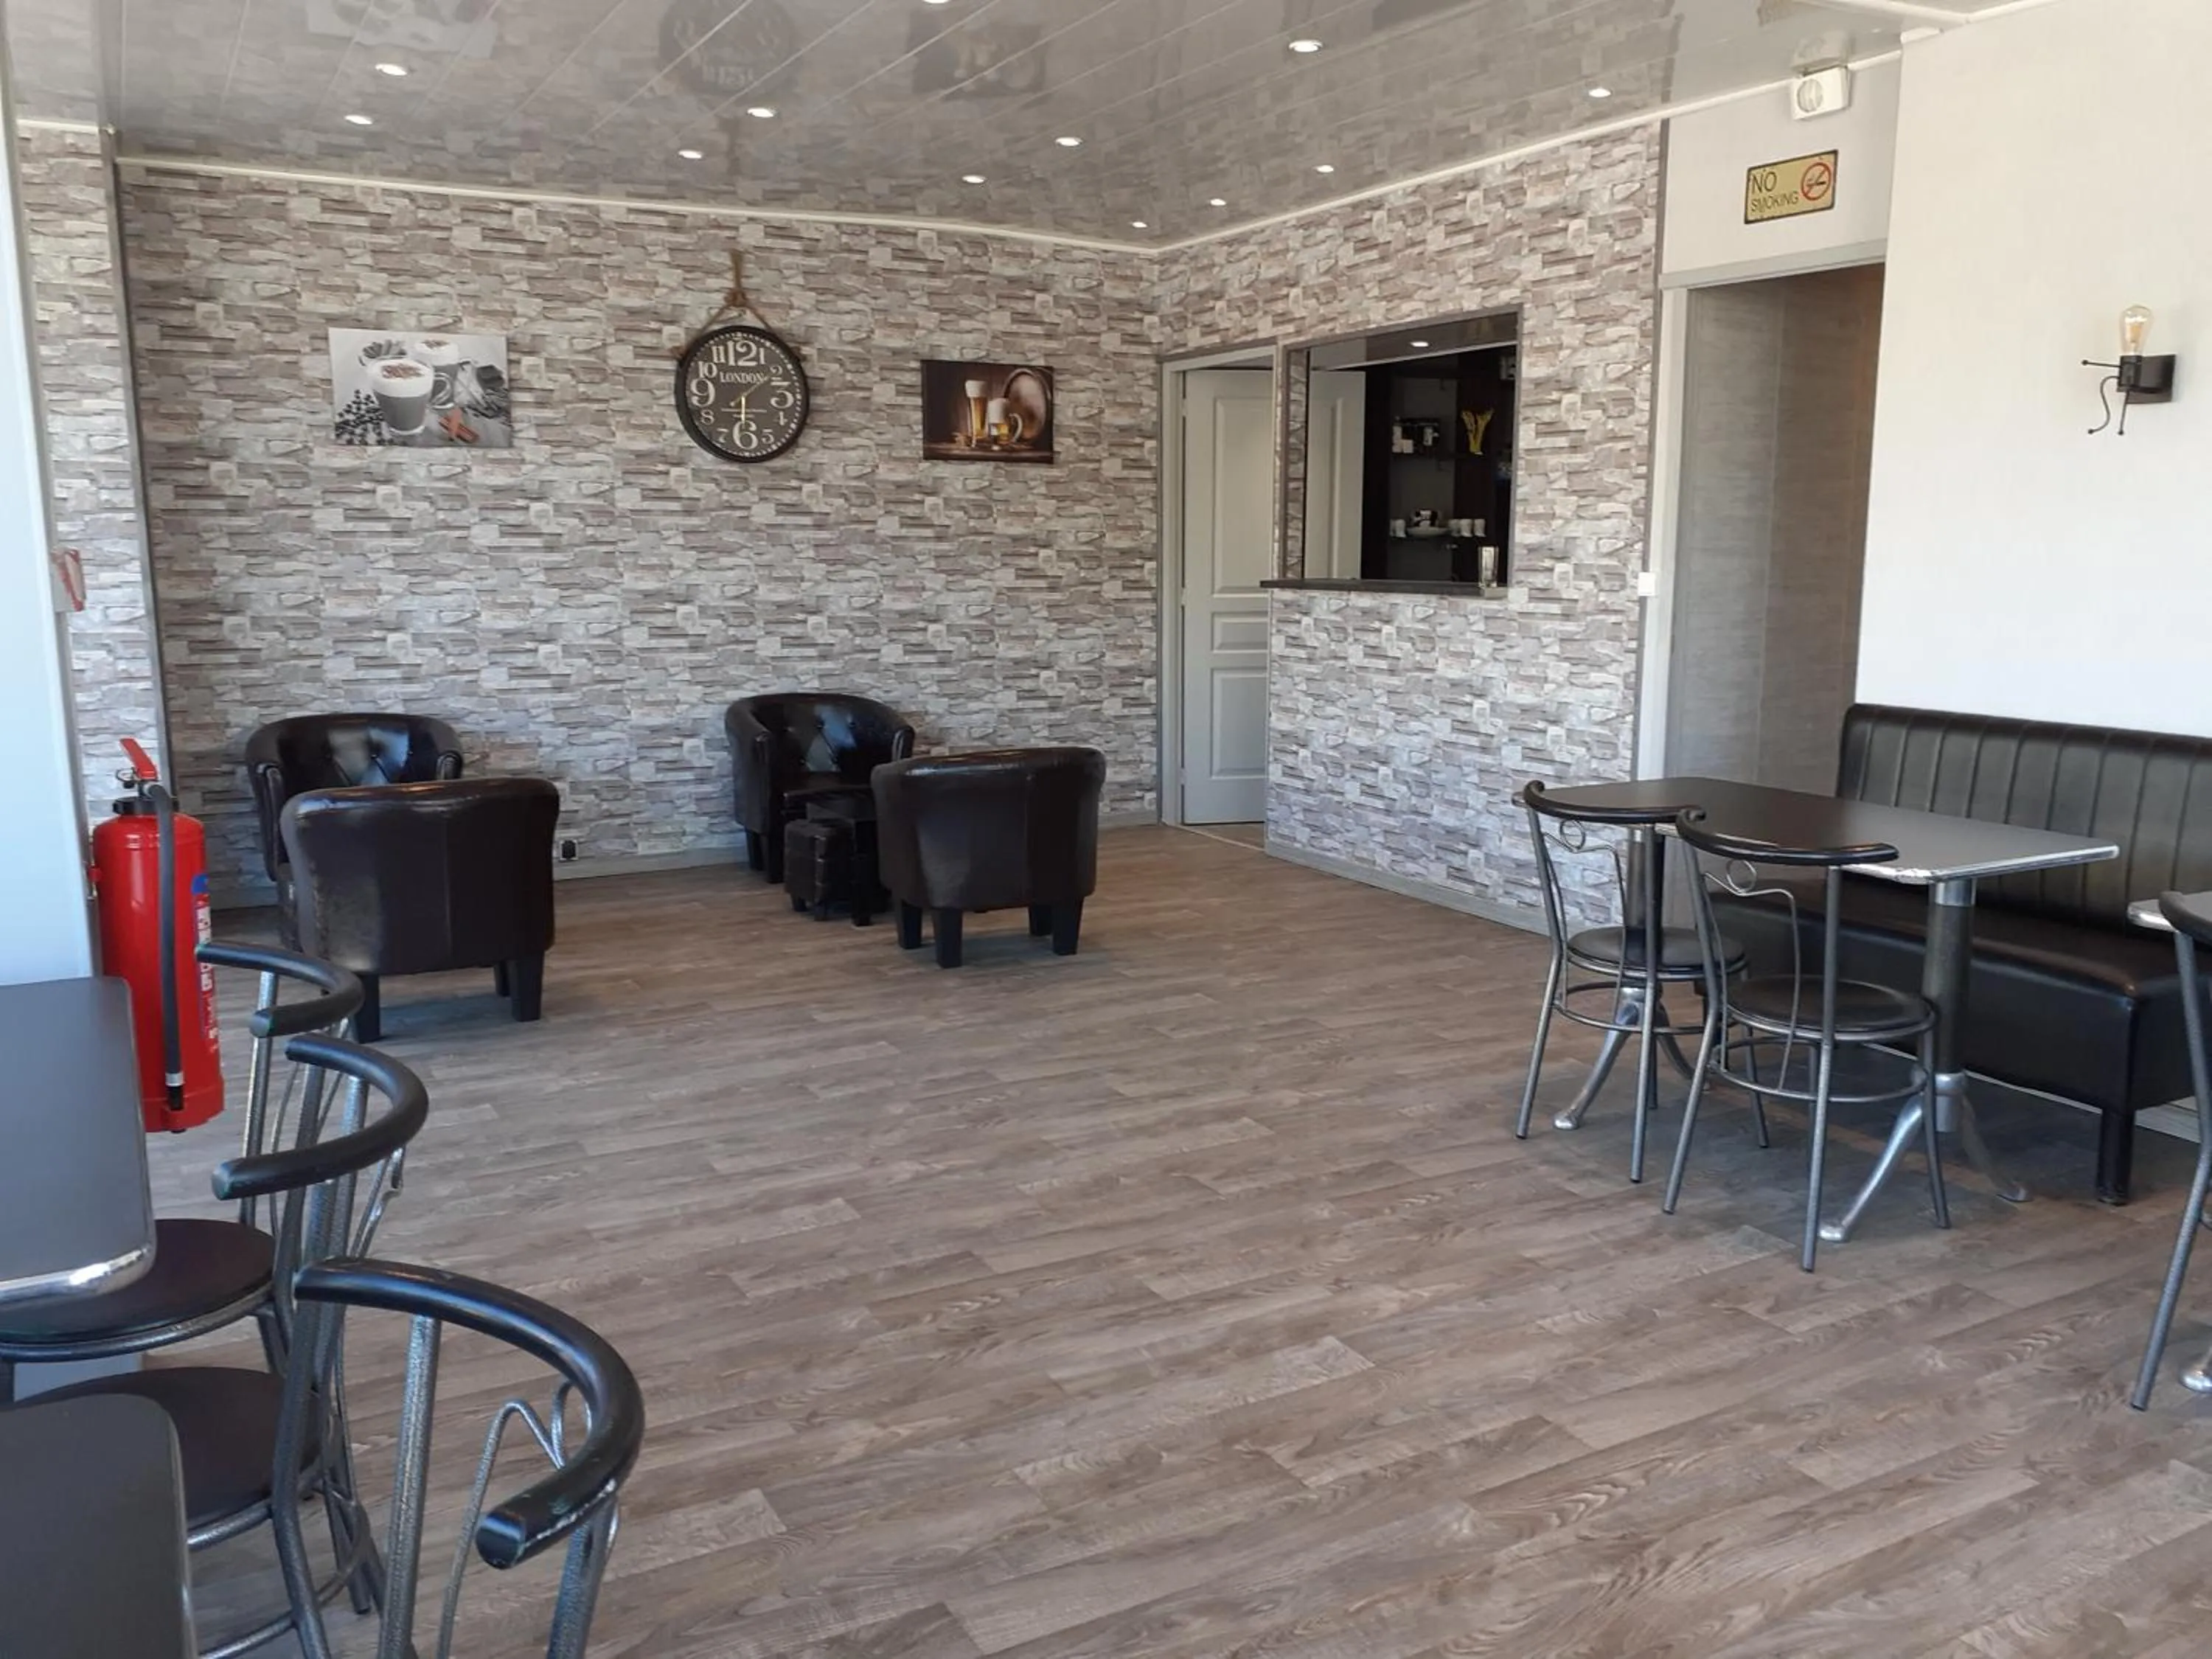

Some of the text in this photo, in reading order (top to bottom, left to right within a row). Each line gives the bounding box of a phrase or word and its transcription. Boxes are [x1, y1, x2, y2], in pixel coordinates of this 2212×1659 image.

[1752, 171, 1777, 194] NO
[1751, 190, 1799, 212] SMOKING
[712, 346, 726, 363] 11
[727, 341, 758, 366] 12
[759, 348, 765, 364] 1
[698, 361, 717, 378] 10
[720, 372, 764, 383] LONDON
[690, 378, 715, 406] 9
[701, 409, 714, 425] 8
[717, 428, 728, 442] 7
[733, 420, 758, 449] 6
[762, 429, 774, 444] 5
